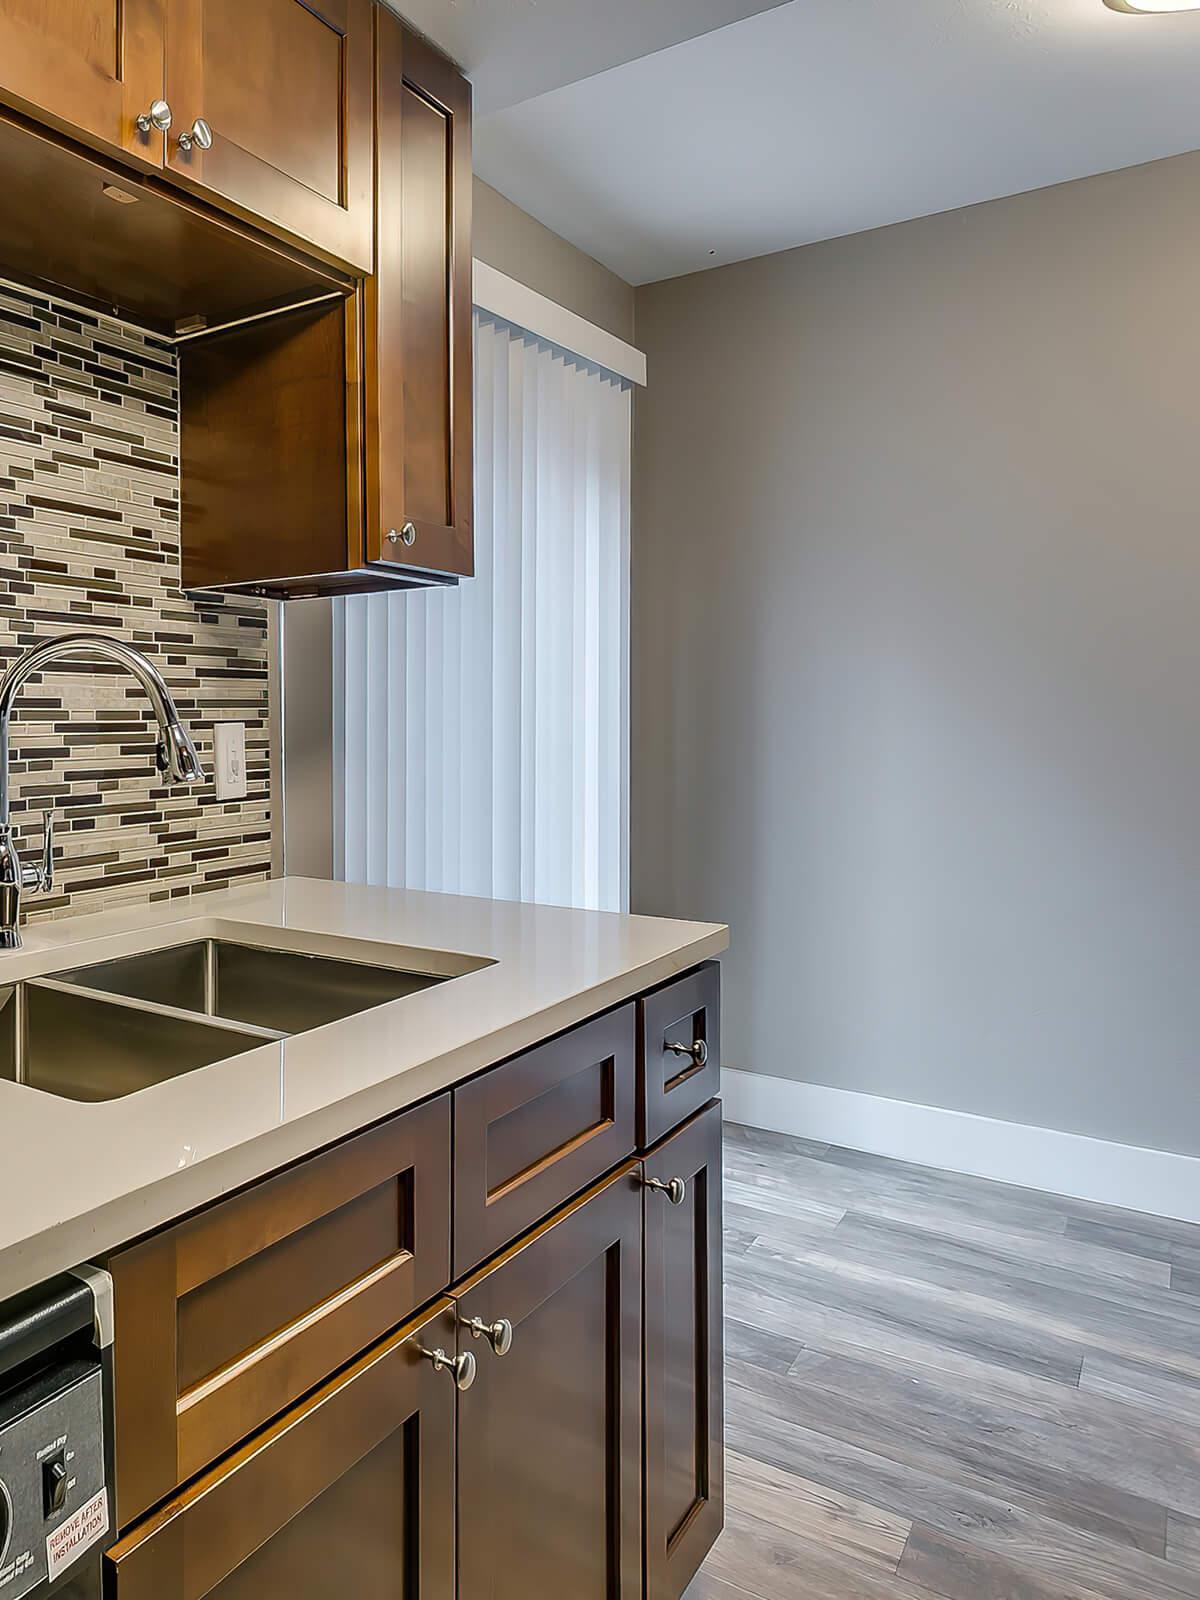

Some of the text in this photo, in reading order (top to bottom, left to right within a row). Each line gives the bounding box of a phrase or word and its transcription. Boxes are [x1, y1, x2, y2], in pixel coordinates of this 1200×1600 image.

[49, 1516, 81, 1550] REMOVE
[80, 1496, 103, 1525] AFTER
[52, 1513, 103, 1563] INSTALLATION
